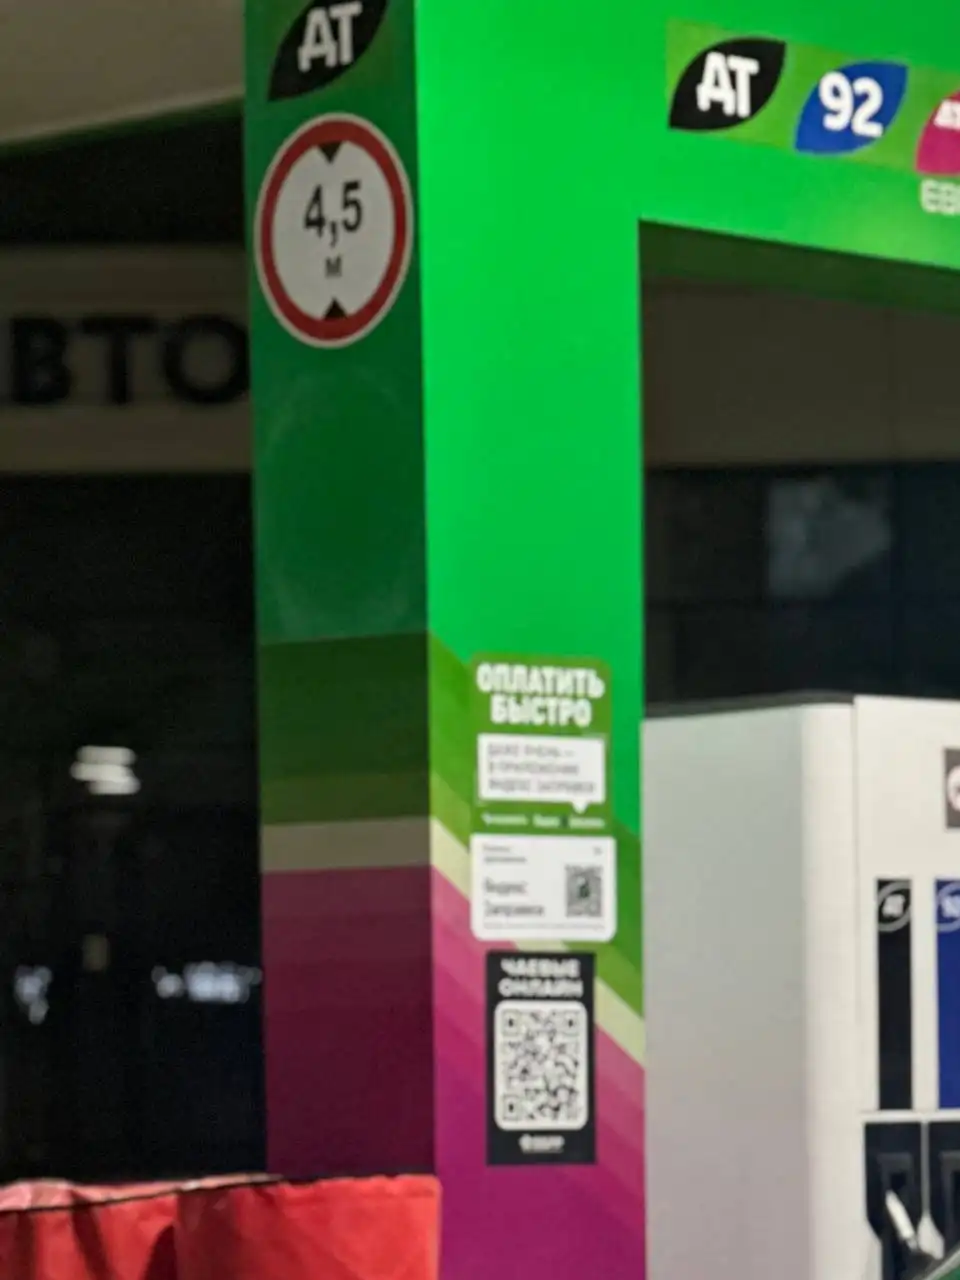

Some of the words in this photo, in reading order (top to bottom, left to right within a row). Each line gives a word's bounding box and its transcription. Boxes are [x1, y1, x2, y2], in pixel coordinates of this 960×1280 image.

[818, 72, 884, 138] 92
[303, 180, 363, 248] 4,5
[477, 662, 606, 698] ОПЛАТИТЬ
[490, 693, 593, 727] БЫСТРО
